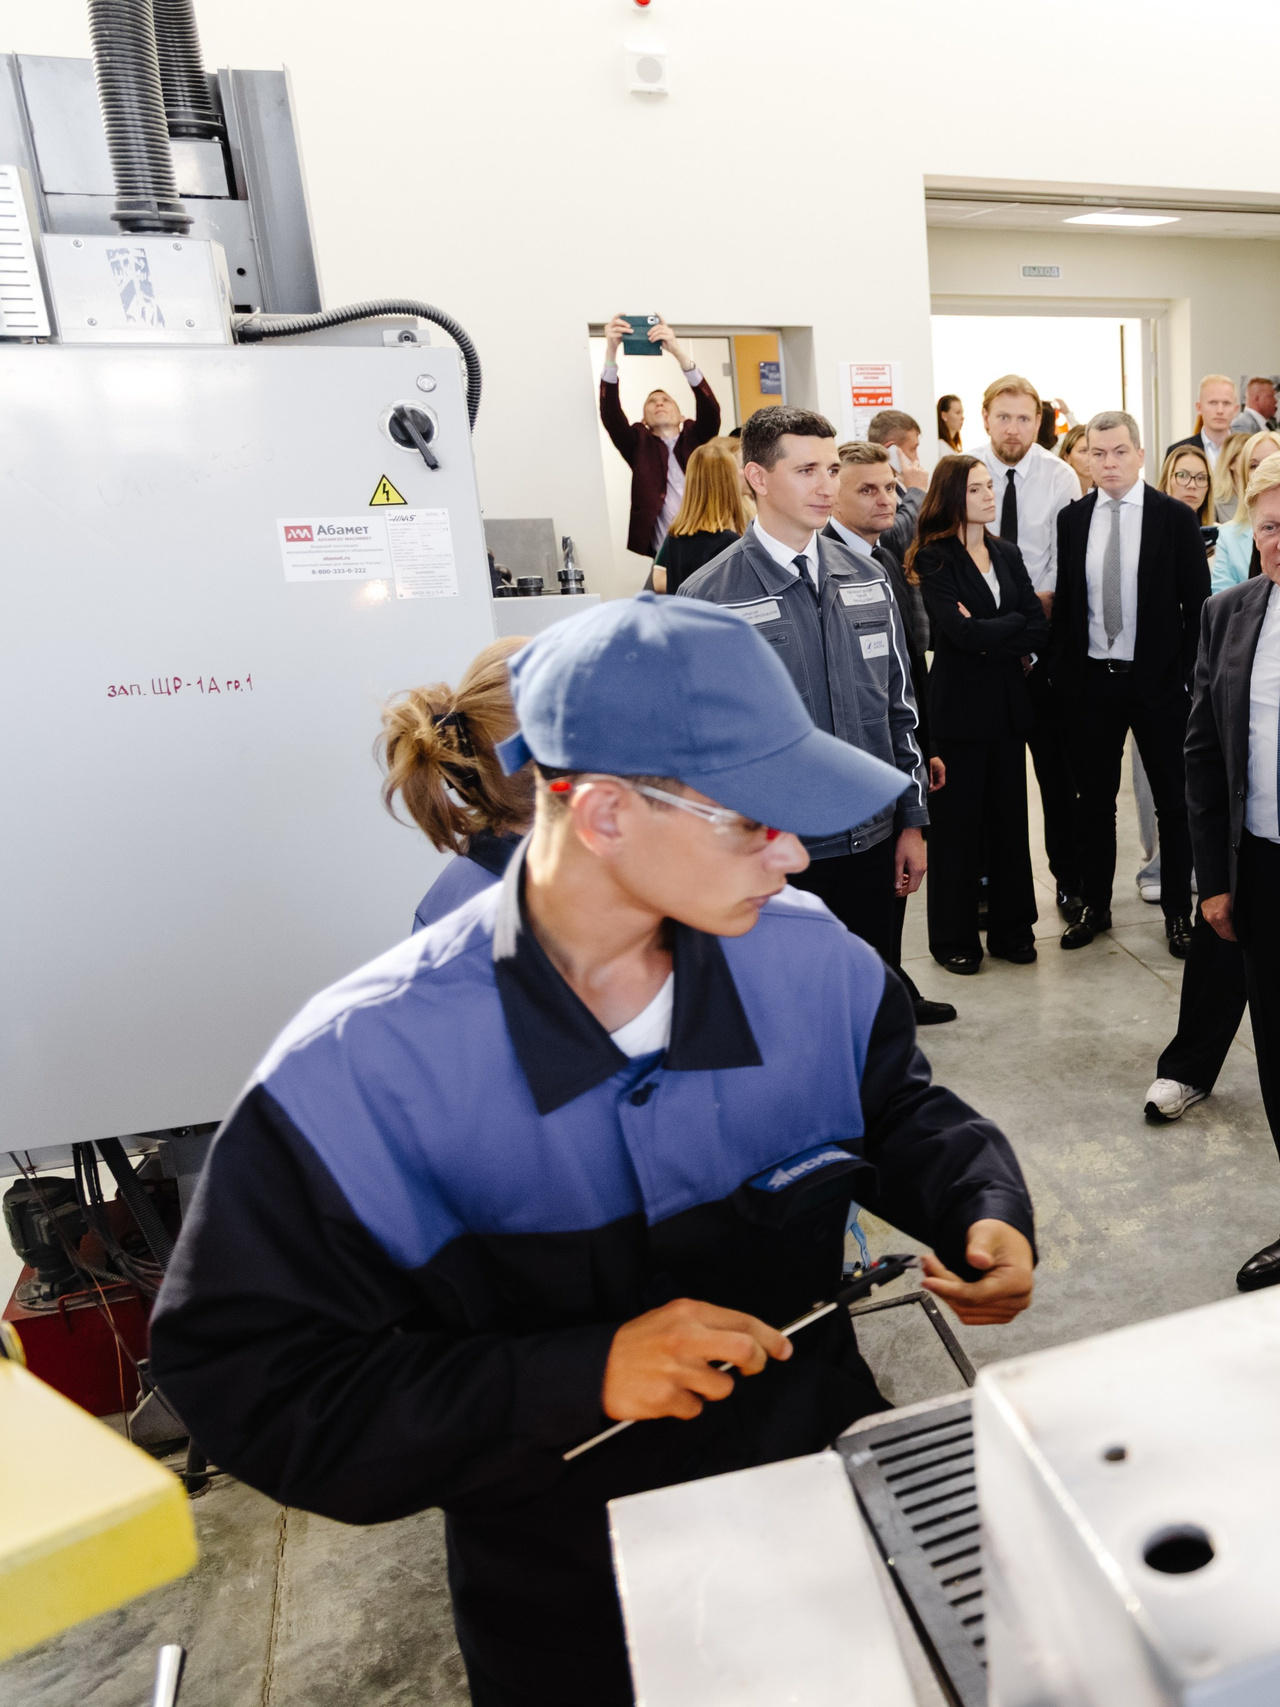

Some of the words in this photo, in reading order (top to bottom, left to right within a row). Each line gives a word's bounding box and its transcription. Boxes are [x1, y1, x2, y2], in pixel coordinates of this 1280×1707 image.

[1023, 266, 1059, 277] ВЫХОД
[317, 524, 369, 536] Абамет
[312, 567, 367, 575] 8-800-333-0-222
